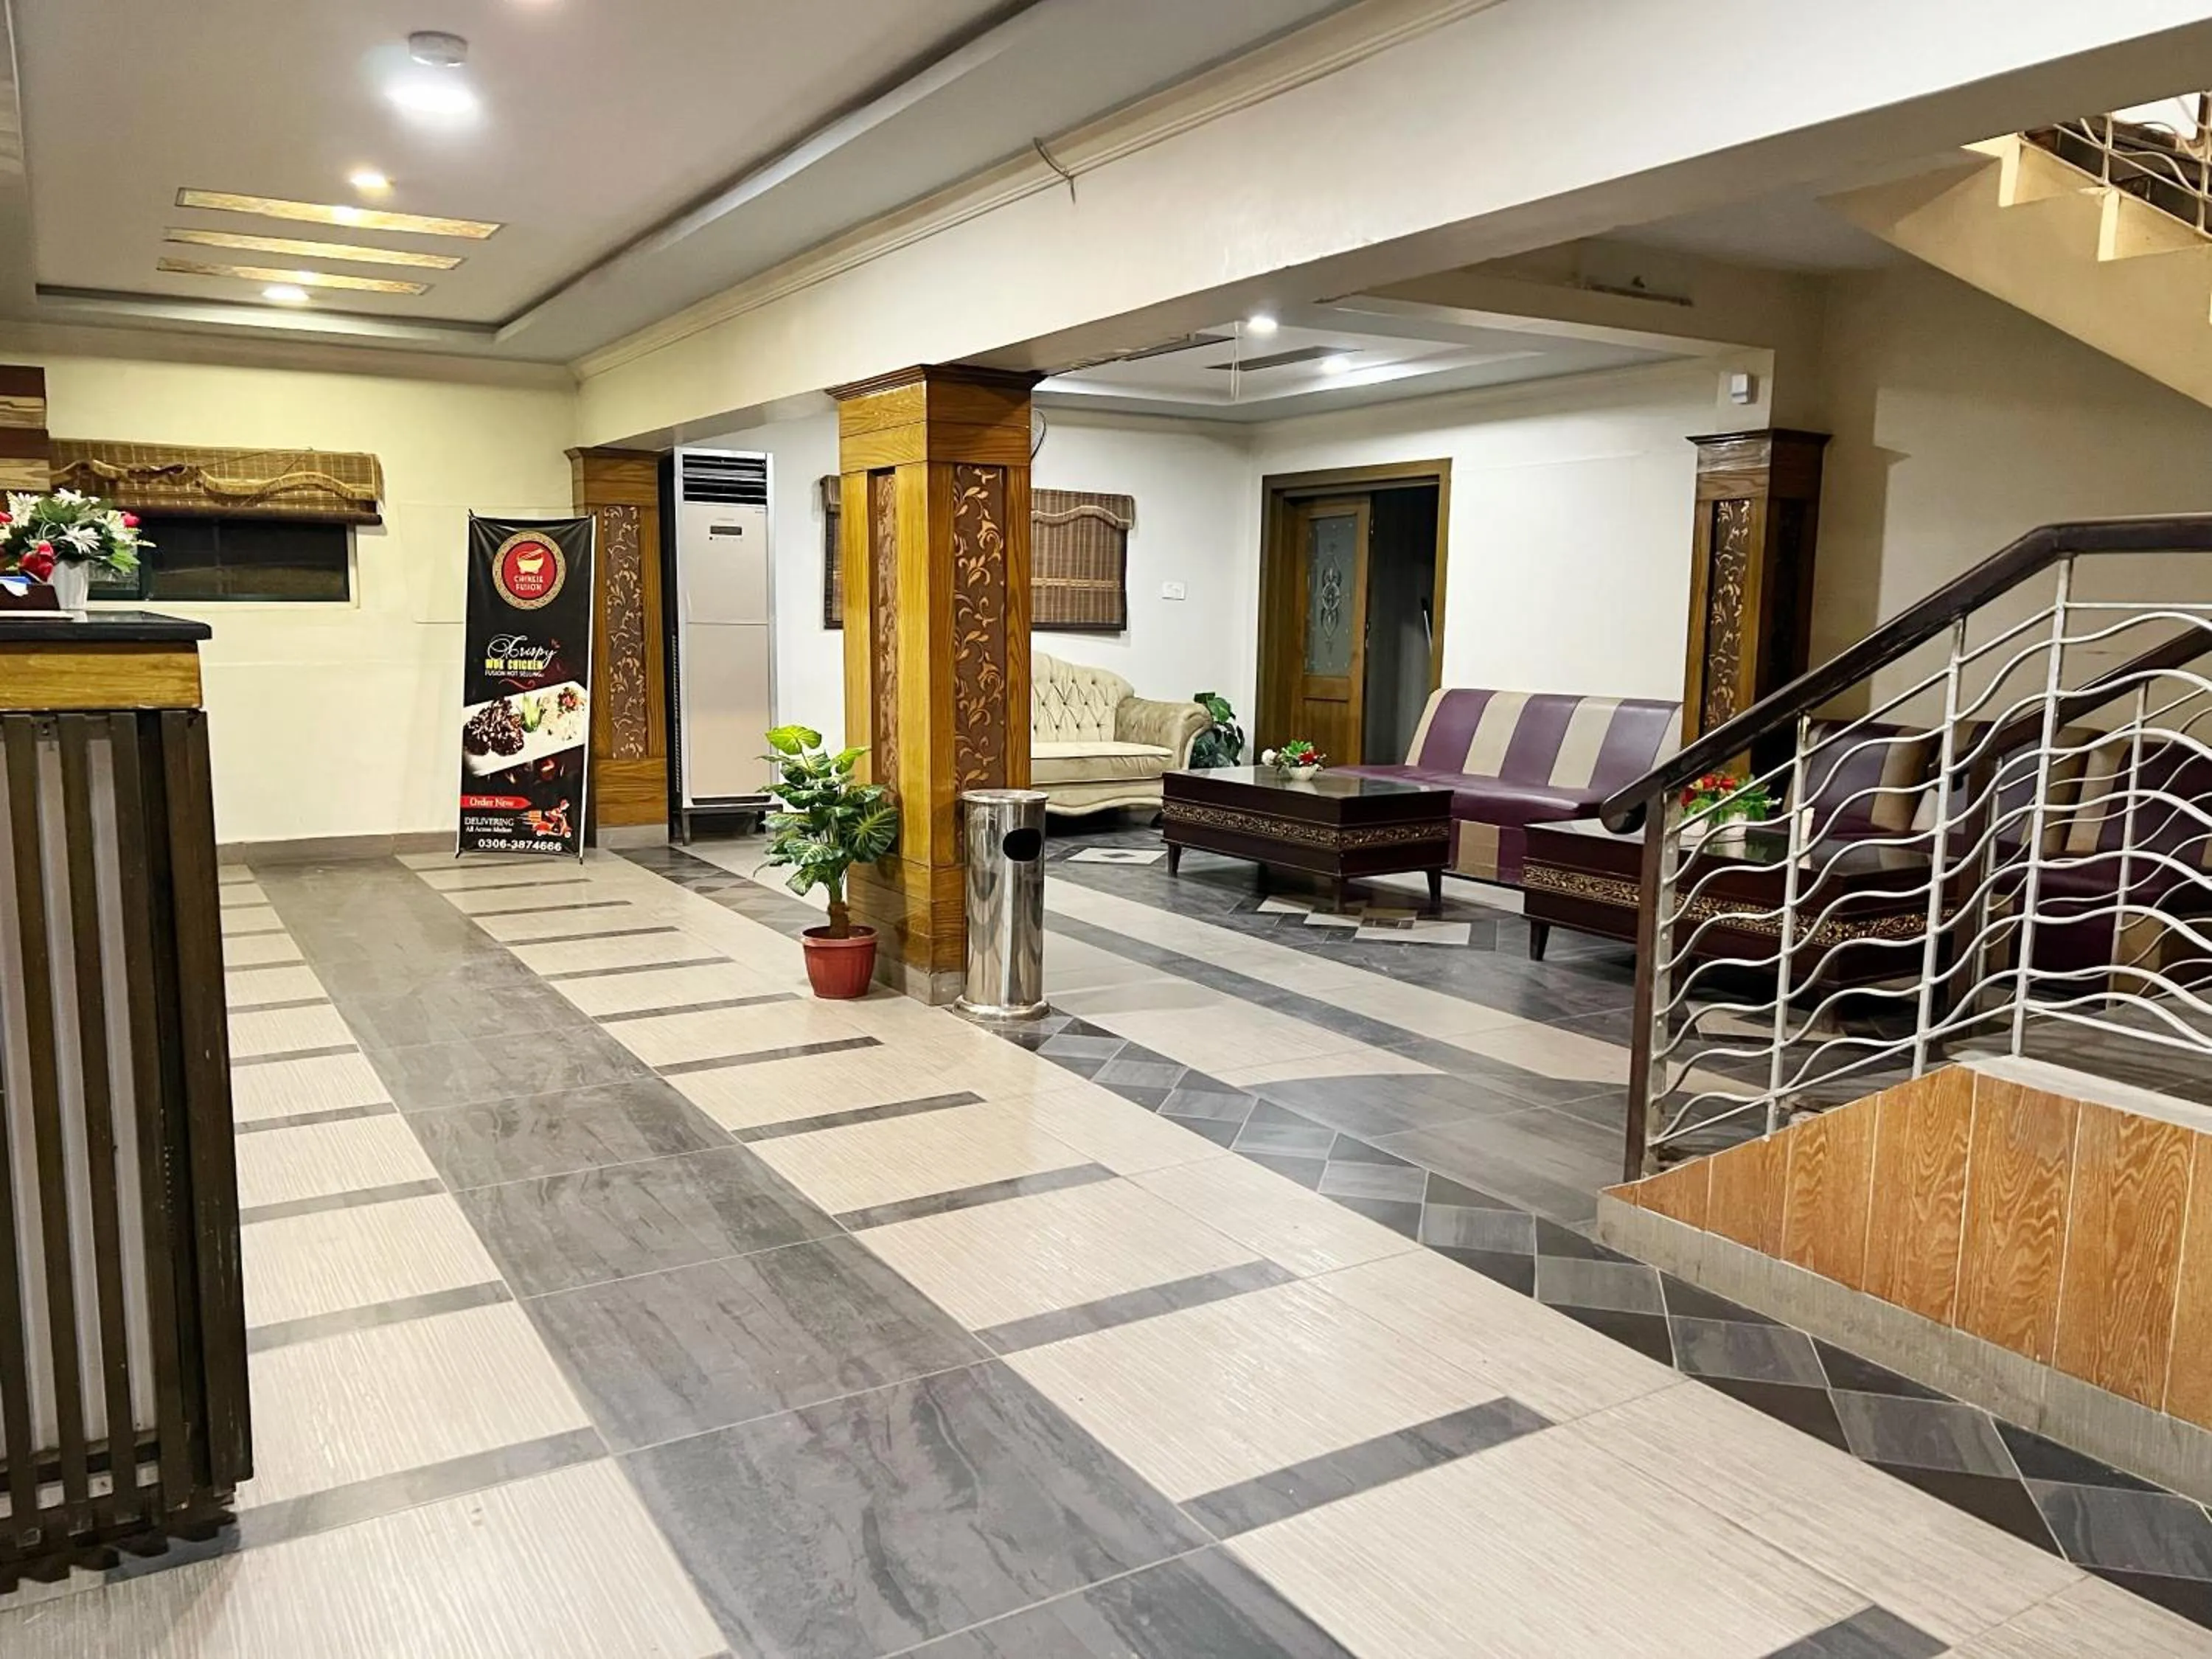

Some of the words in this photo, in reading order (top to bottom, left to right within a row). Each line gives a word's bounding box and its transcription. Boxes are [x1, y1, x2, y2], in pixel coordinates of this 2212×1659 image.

[507, 659, 543, 670] CHICKEN
[470, 797, 494, 806] Order
[495, 797, 515, 807] Now
[464, 816, 514, 826] DELIVERING
